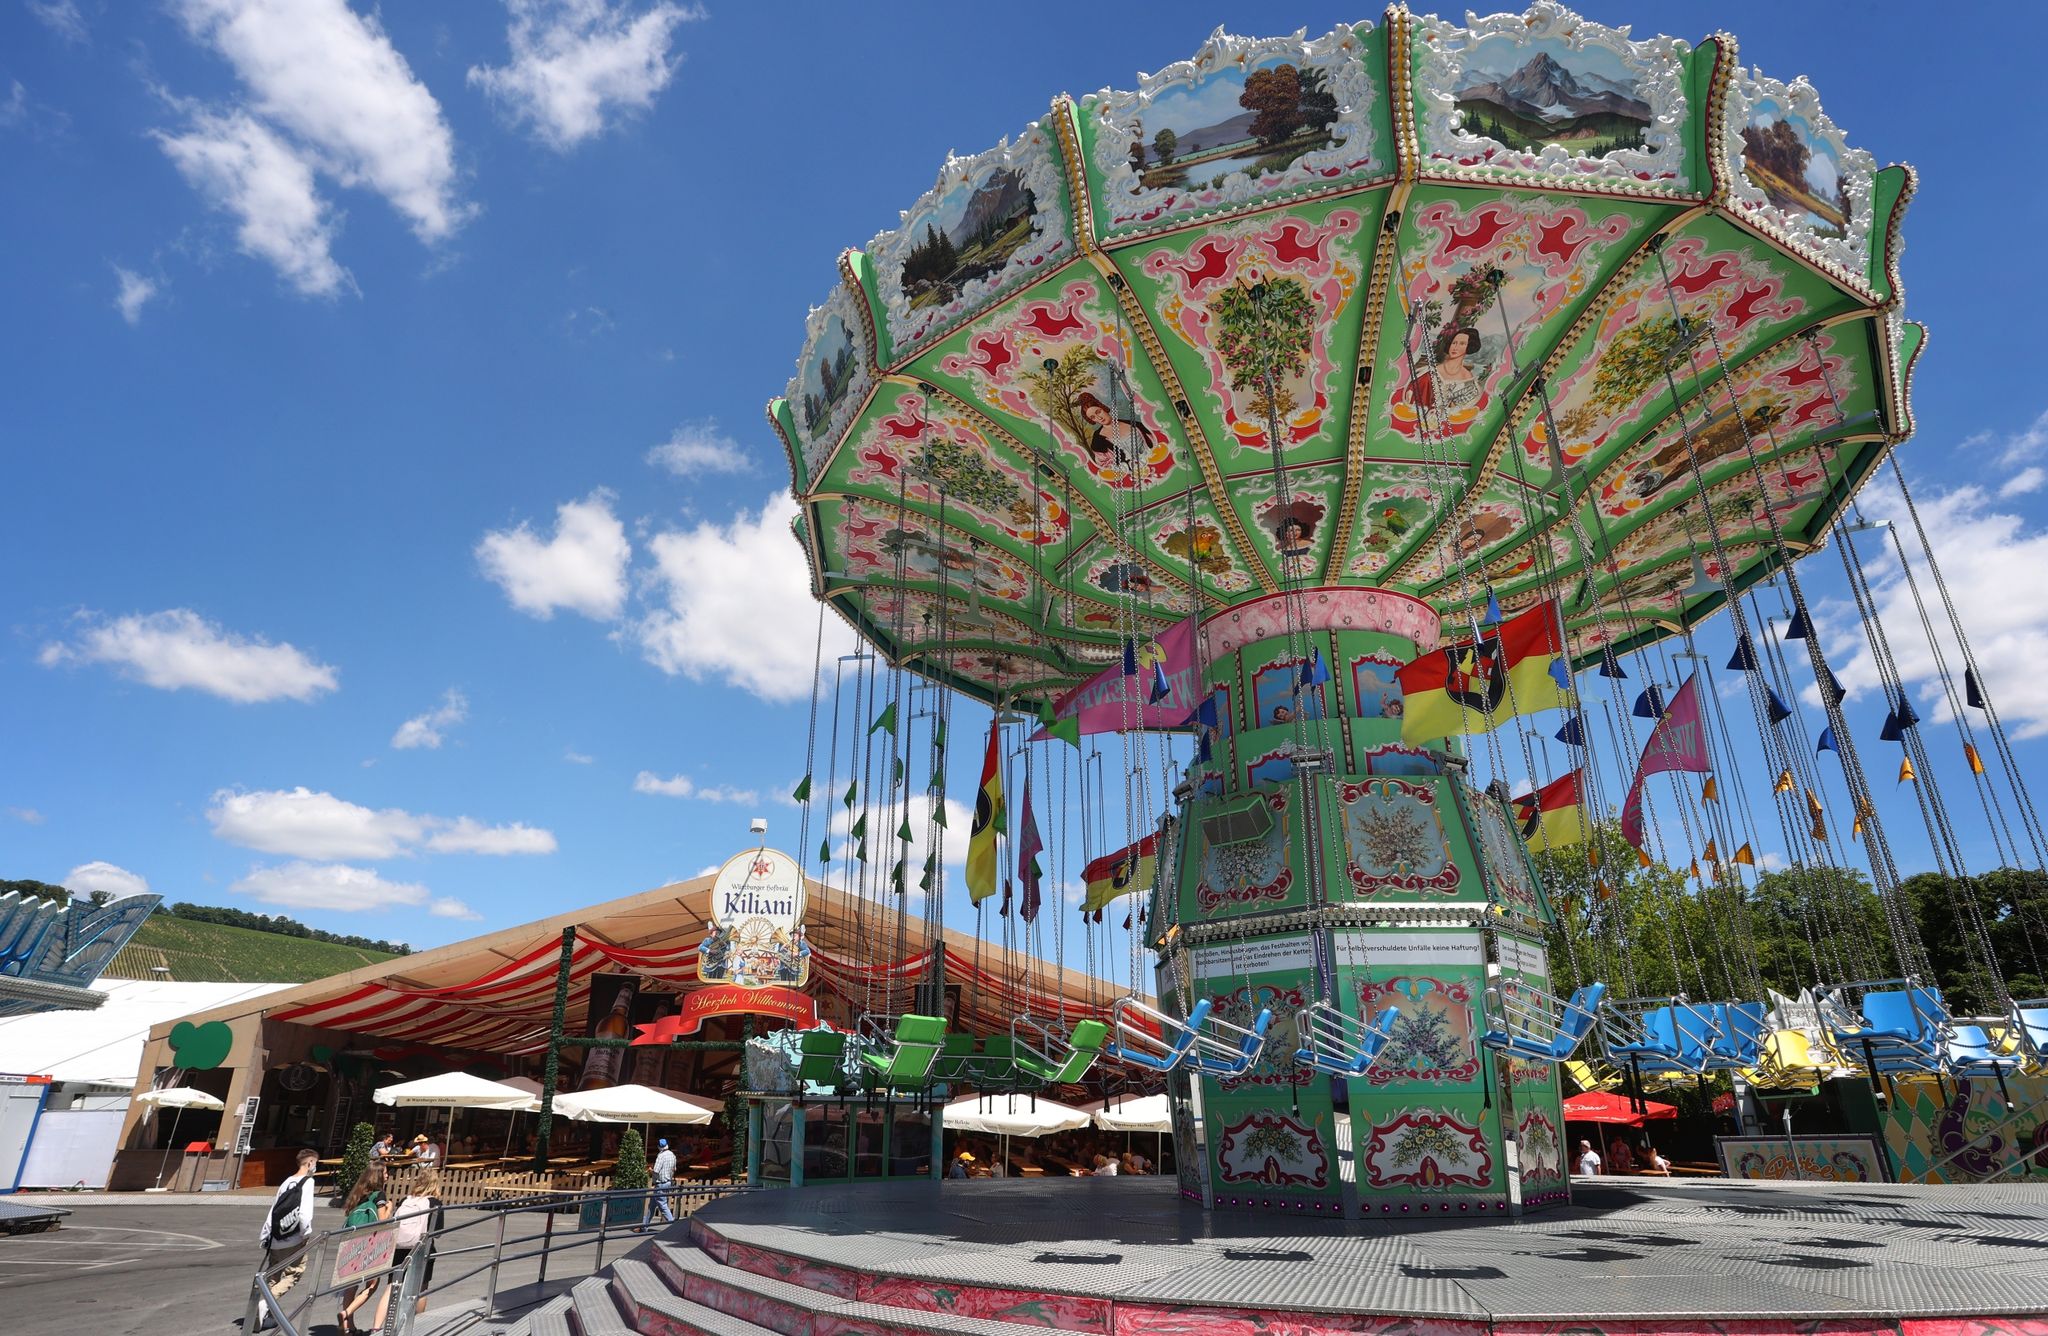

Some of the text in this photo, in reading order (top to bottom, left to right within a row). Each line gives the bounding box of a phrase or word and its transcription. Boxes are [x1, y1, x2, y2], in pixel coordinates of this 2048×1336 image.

[724, 892, 793, 916] Kiliani
[1271, 942, 1301, 950] Festhalten
[1451, 944, 1480, 952] Haftung!
[1253, 951, 1282, 960] Eindrehen
[691, 988, 808, 1014] Herzlich Willkommen
